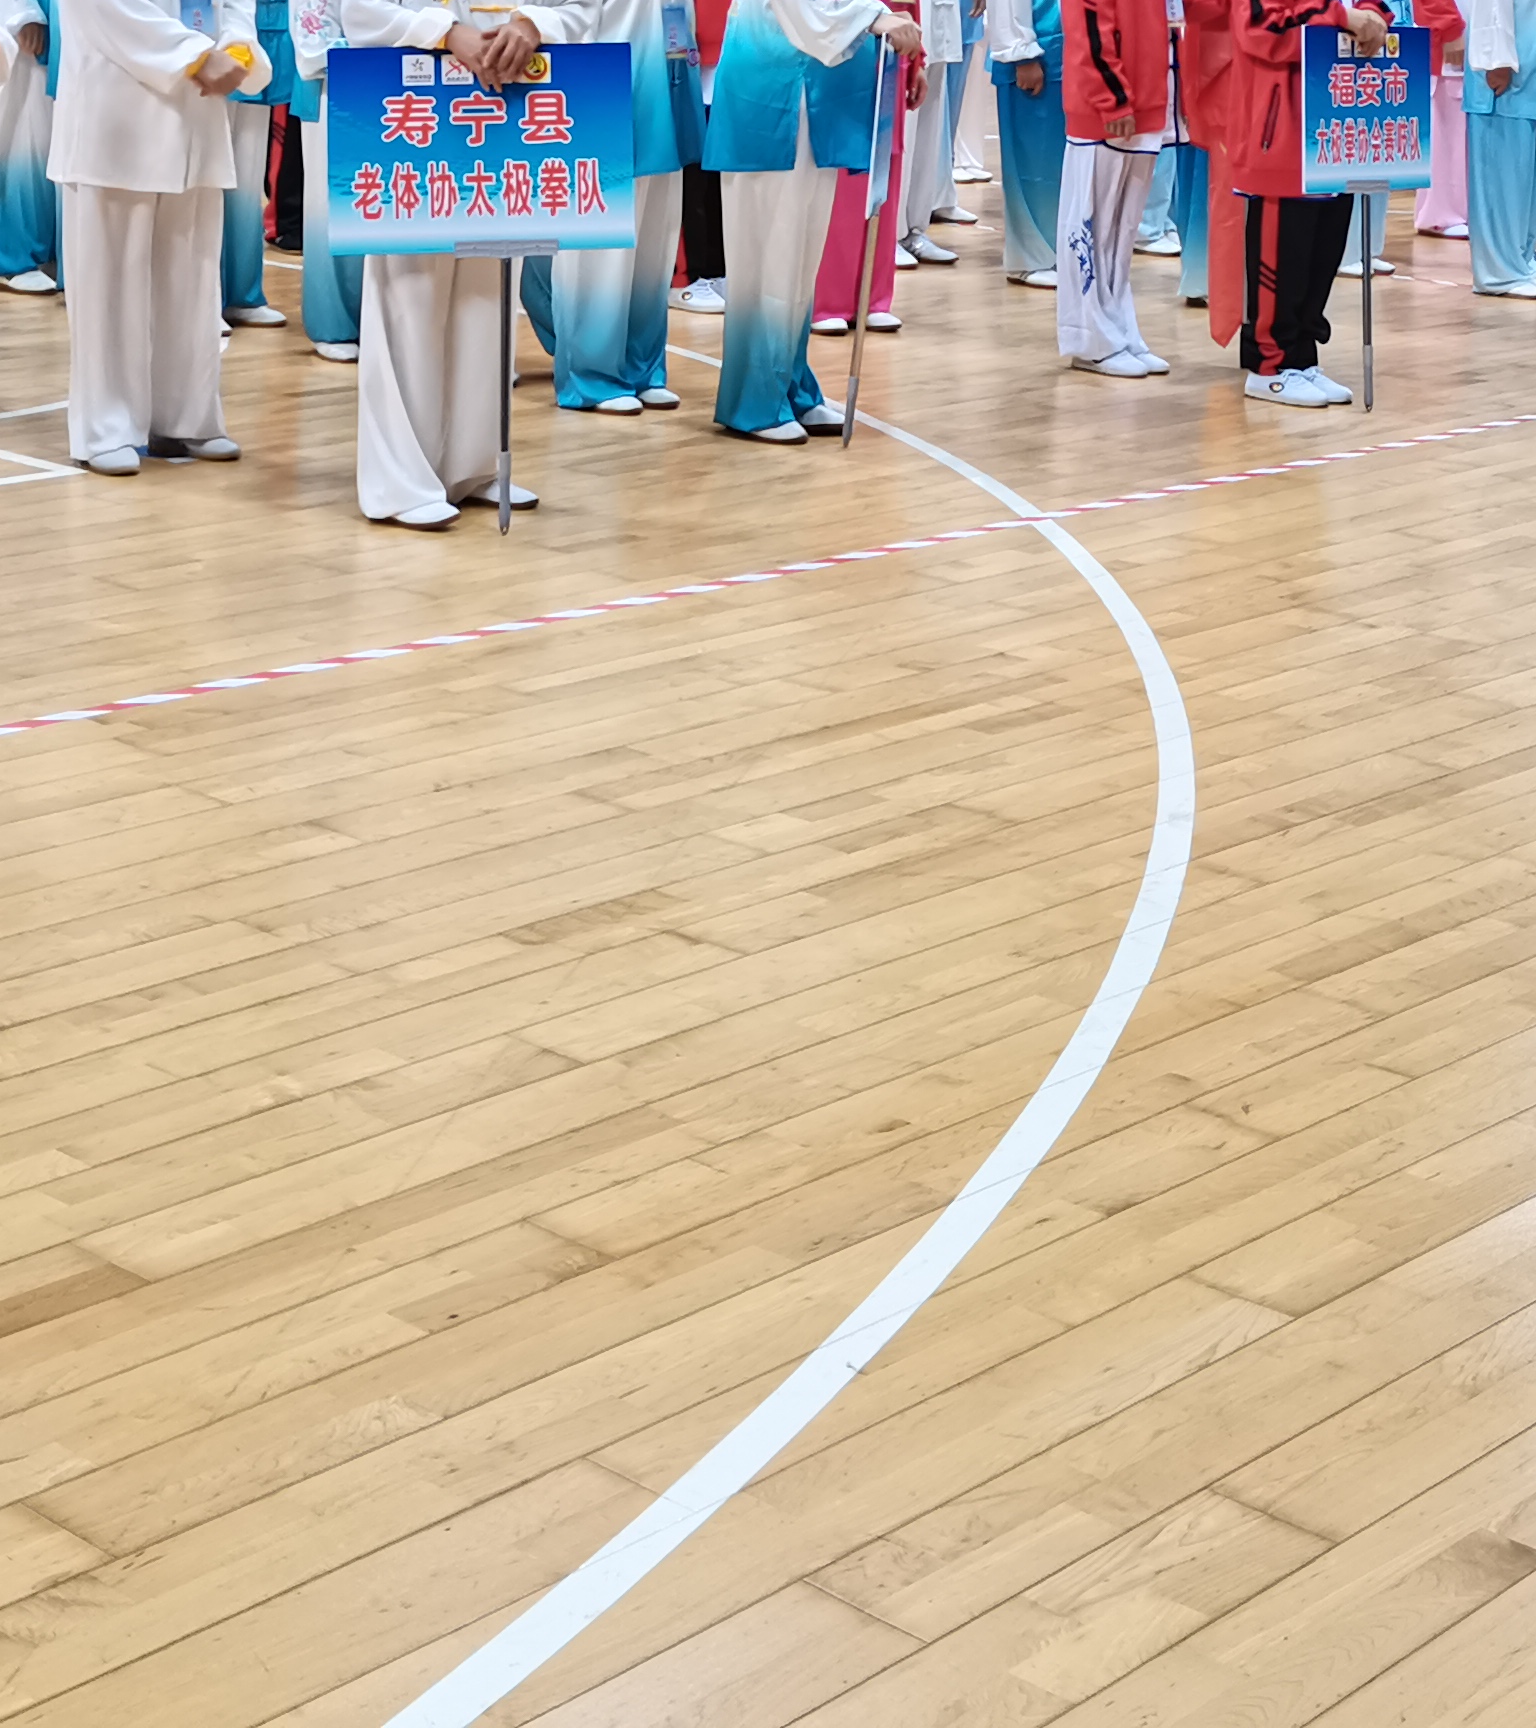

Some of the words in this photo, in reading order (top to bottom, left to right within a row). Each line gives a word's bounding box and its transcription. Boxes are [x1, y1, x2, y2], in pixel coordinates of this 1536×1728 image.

[1328, 62, 1409, 107] 福安市
[380, 90, 574, 148] 寿宁县
[351, 157, 608, 221] 老体协太极拳队
